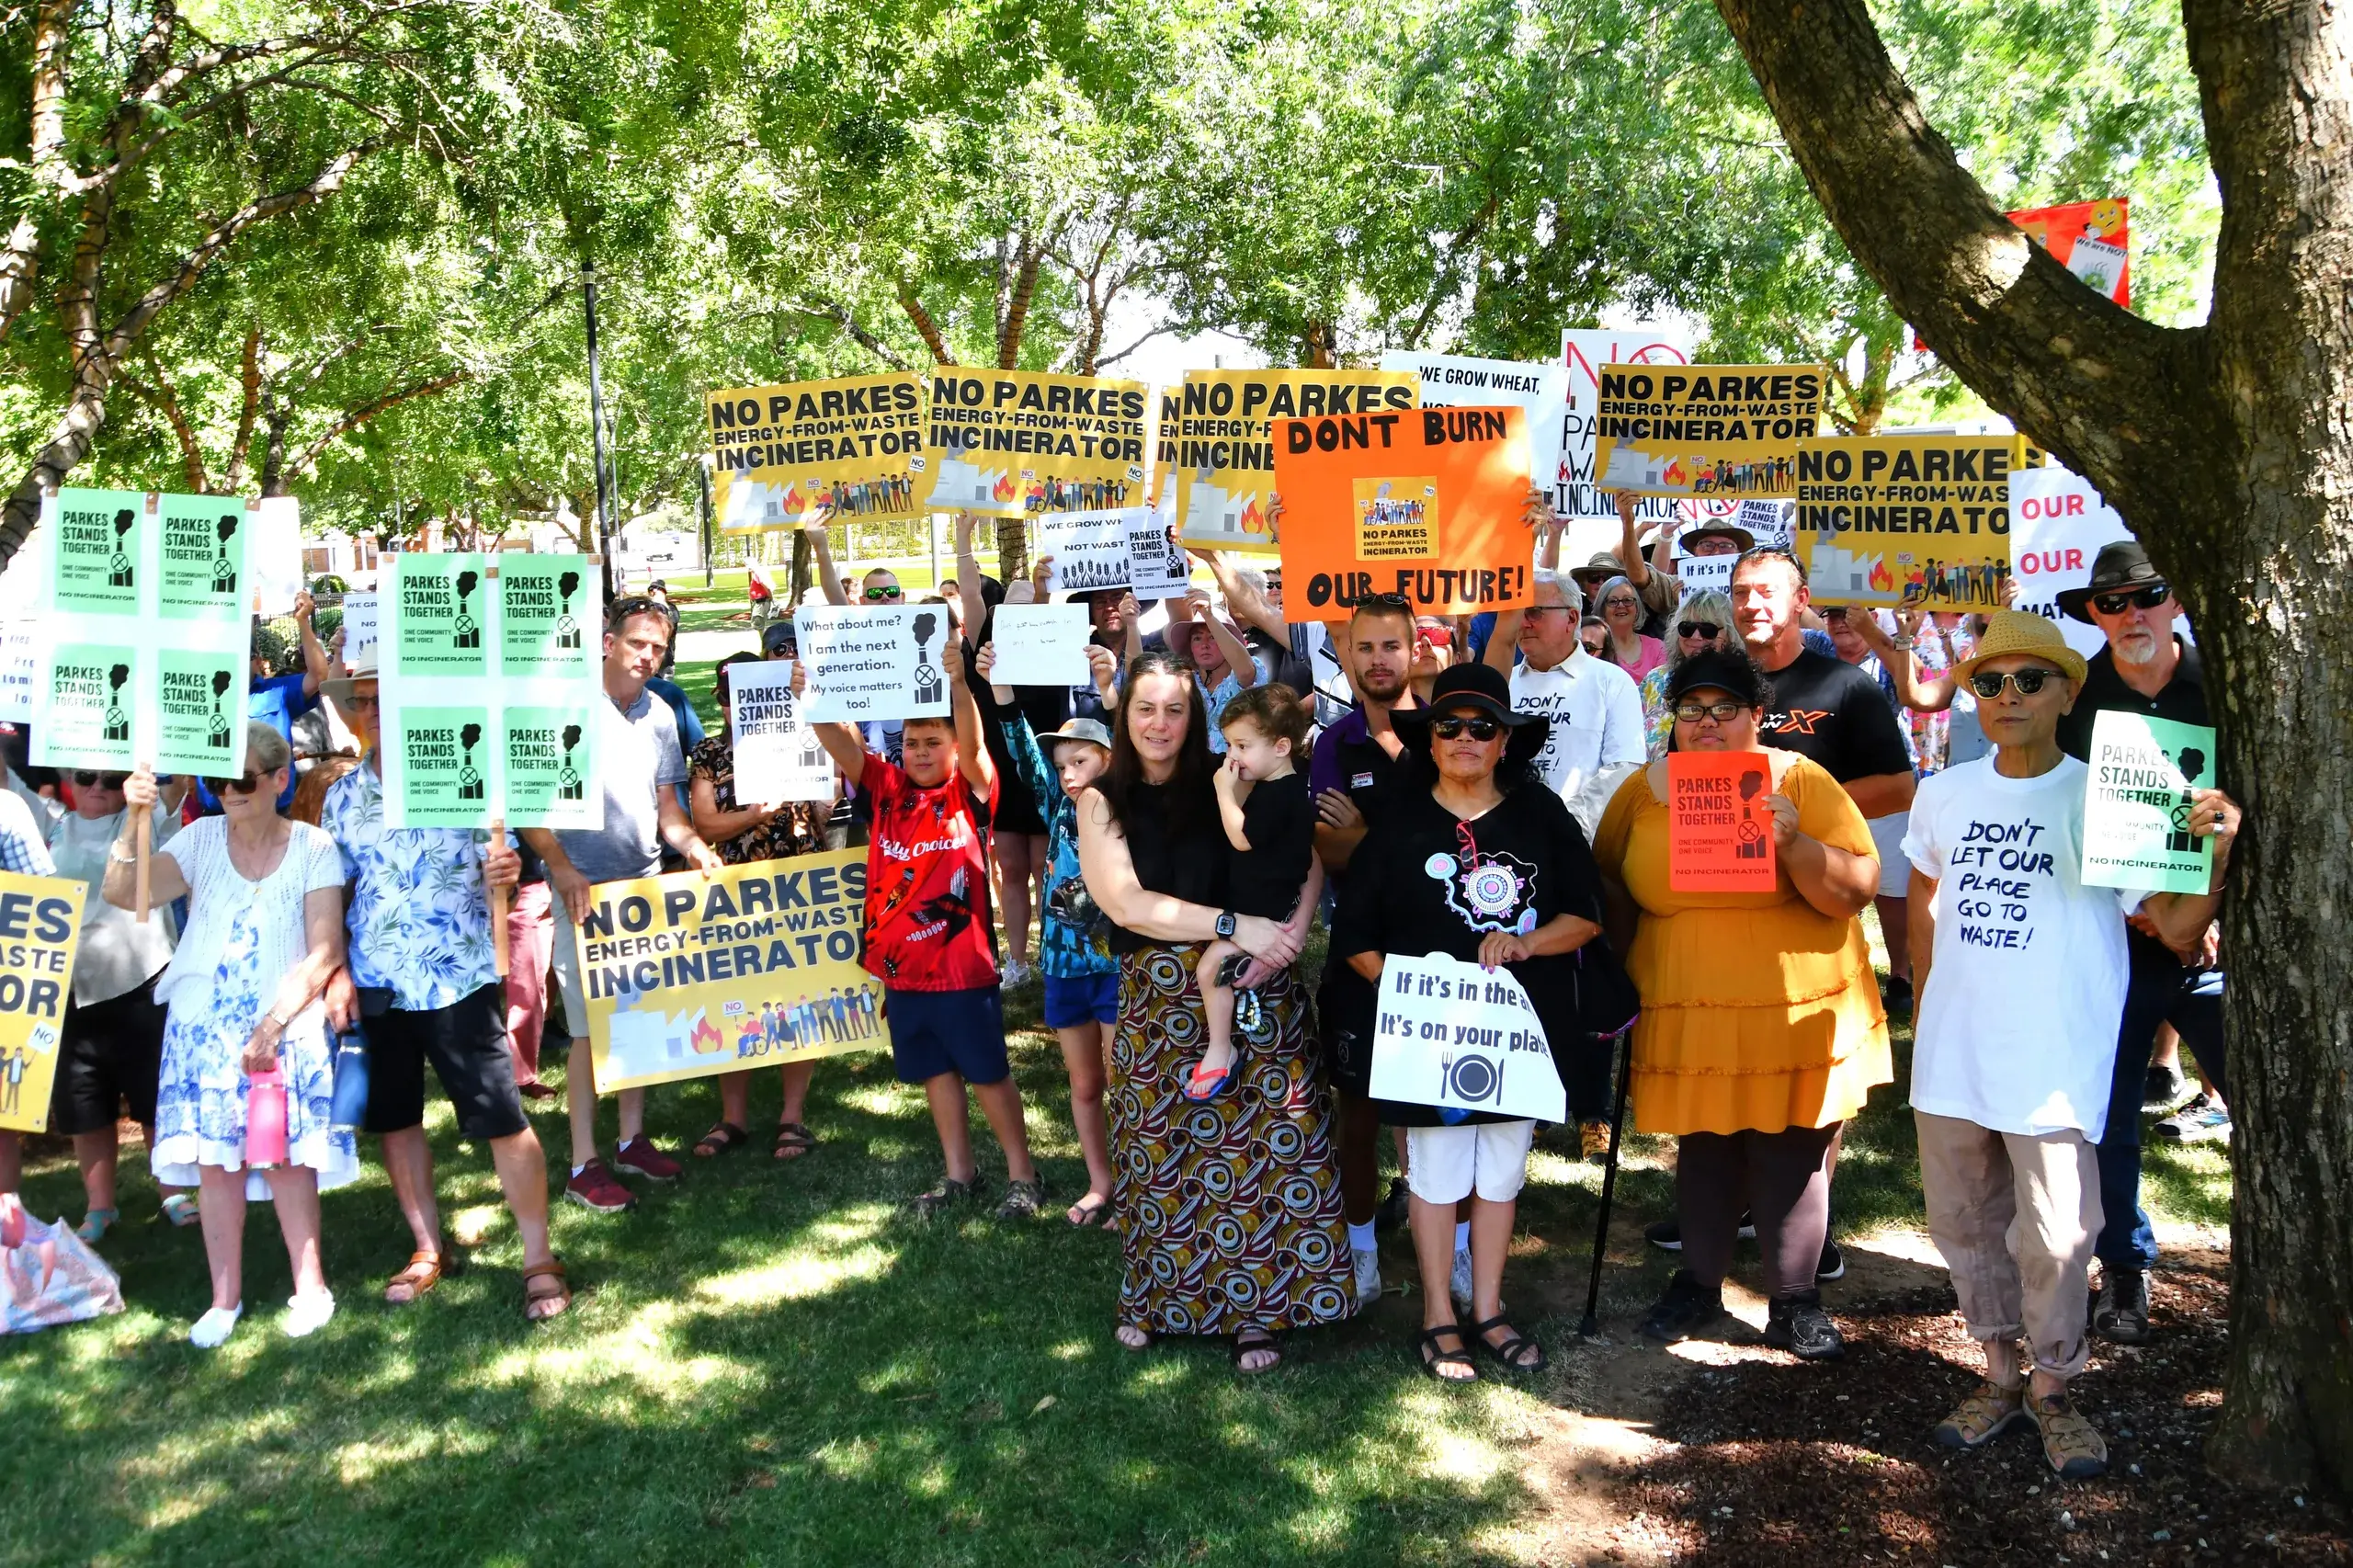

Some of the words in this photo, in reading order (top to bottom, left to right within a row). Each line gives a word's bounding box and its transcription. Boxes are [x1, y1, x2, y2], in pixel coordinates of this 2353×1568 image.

[1420, 366, 1441, 382] WE
[1446, 369, 1488, 387] GROW
[1492, 373, 1540, 395] WHEAT,
[1601, 375, 1653, 400] NO
[1663, 375, 1818, 401] PARKES
[712, 399, 760, 428] NO
[769, 383, 917, 423] PARKES
[933, 378, 984, 405] NO
[994, 381, 1144, 418] PARKES
[1184, 382, 1233, 415] NO
[1243, 383, 1412, 417] PARKES
[1600, 402, 1816, 415] ENERGY-FROM-WASTE
[932, 407, 1142, 436] ENERGY-FROM-WASTE
[1599, 417, 1814, 440] INCINERATOR
[714, 414, 919, 445] ENERGY-FROM-WASTE
[1288, 415, 1399, 454] DONT
[1424, 412, 1506, 446] BURN
[930, 425, 1142, 461] INCINERATOR
[716, 431, 922, 471] INCINERATOR
[912, 459, 925, 467] NO
[1798, 450, 1852, 482] NO
[1129, 467, 1142, 478] NO
[1743, 501, 1778, 513] PARKES
[2021, 494, 2085, 519] OUR
[63, 511, 108, 526] PARKES
[166, 517, 210, 532] PARKES
[1741, 511, 1776, 523] STANDS
[1739, 520, 1775, 532] TOGETHER
[63, 527, 108, 541] STANDS
[165, 533, 210, 548] STANDS
[1130, 530, 1161, 541] PARKES
[1363, 530, 1378, 539] NO
[1381, 529, 1427, 539] PARKES
[63, 542, 109, 555] TOGETHER
[1131, 540, 1162, 551] STANDS
[1364, 547, 1427, 555] INCINERATOR
[165, 549, 212, 561] TOGETHER
[1132, 551, 1165, 560] TOGETHER
[2020, 549, 2084, 574] OUR
[1687, 566, 1694, 576] If
[1698, 564, 1713, 575] it's
[1718, 563, 1727, 574] in
[404, 576, 449, 589] PARKES
[506, 577, 551, 590] PARKES
[1307, 572, 1372, 608] OUR
[1397, 565, 1524, 604] FUTURE!
[404, 592, 449, 604] STANDS
[506, 593, 552, 605] STANDS
[404, 607, 453, 618] TOGETHER
[506, 608, 555, 618] TOGETHER
[802, 620, 834, 631] What
[837, 619, 872, 630] about
[877, 615, 901, 627] me?
[809, 643, 812, 654] I
[816, 645, 836, 654] am
[840, 641, 861, 653] the
[866, 640, 896, 652] next
[55, 665, 103, 680] PARKES
[817, 659, 894, 676] generation.
[164, 672, 206, 687] PARKES
[55, 681, 102, 696] STANDS
[163, 688, 206, 702] STANDS
[737, 686, 791, 704] PARKES
[811, 684, 825, 696] My
[829, 683, 856, 693] voice
[859, 682, 902, 691] matters
[847, 697, 870, 709] too!
[1514, 692, 1565, 709] DON'T
[163, 703, 208, 716] TOGETHER
[739, 704, 792, 722] STANDS
[407, 729, 454, 742] PARKES
[510, 729, 555, 742] PARKES
[740, 722, 796, 736] TOGETHER
[408, 744, 455, 756] STANDS
[510, 744, 555, 757] STANDS
[173, 754, 231, 762] INCINERATOR
[409, 759, 458, 769] TOGETHER
[511, 759, 558, 769] TOGETHER
[1677, 778, 1732, 793] PARKES
[2099, 767, 2169, 789] STANDS
[1678, 796, 1732, 811] STANDS
[2098, 788, 2170, 807] TOGETHER
[1679, 813, 1735, 825] TOGETHER
[1961, 818, 2044, 846] DON'T
[913, 835, 967, 857] Choices
[1951, 847, 1994, 866] LET
[1999, 849, 2053, 876] OUR
[2112, 859, 2202, 872] INCINERATOR
[1960, 874, 2030, 899] PLACE
[584, 895, 652, 939] NO
[665, 863, 867, 927] PARKES
[1958, 900, 1991, 917] GO
[2002, 903, 2026, 921] TO
[1961, 924, 2033, 949] WASTE!
[588, 928, 864, 999] INCINERATO
[1396, 971, 1412, 994] If
[1419, 974, 1450, 998] it's
[1459, 978, 1478, 1001] in
[1485, 982, 1517, 1006] the
[725, 1002, 741, 1011] NO
[34, 1028, 54, 1044] NO
[1381, 1013, 1413, 1037] It's
[1421, 1022, 1447, 1040] on
[1454, 1026, 1502, 1047] your
[1509, 1029, 1549, 1058] plate
